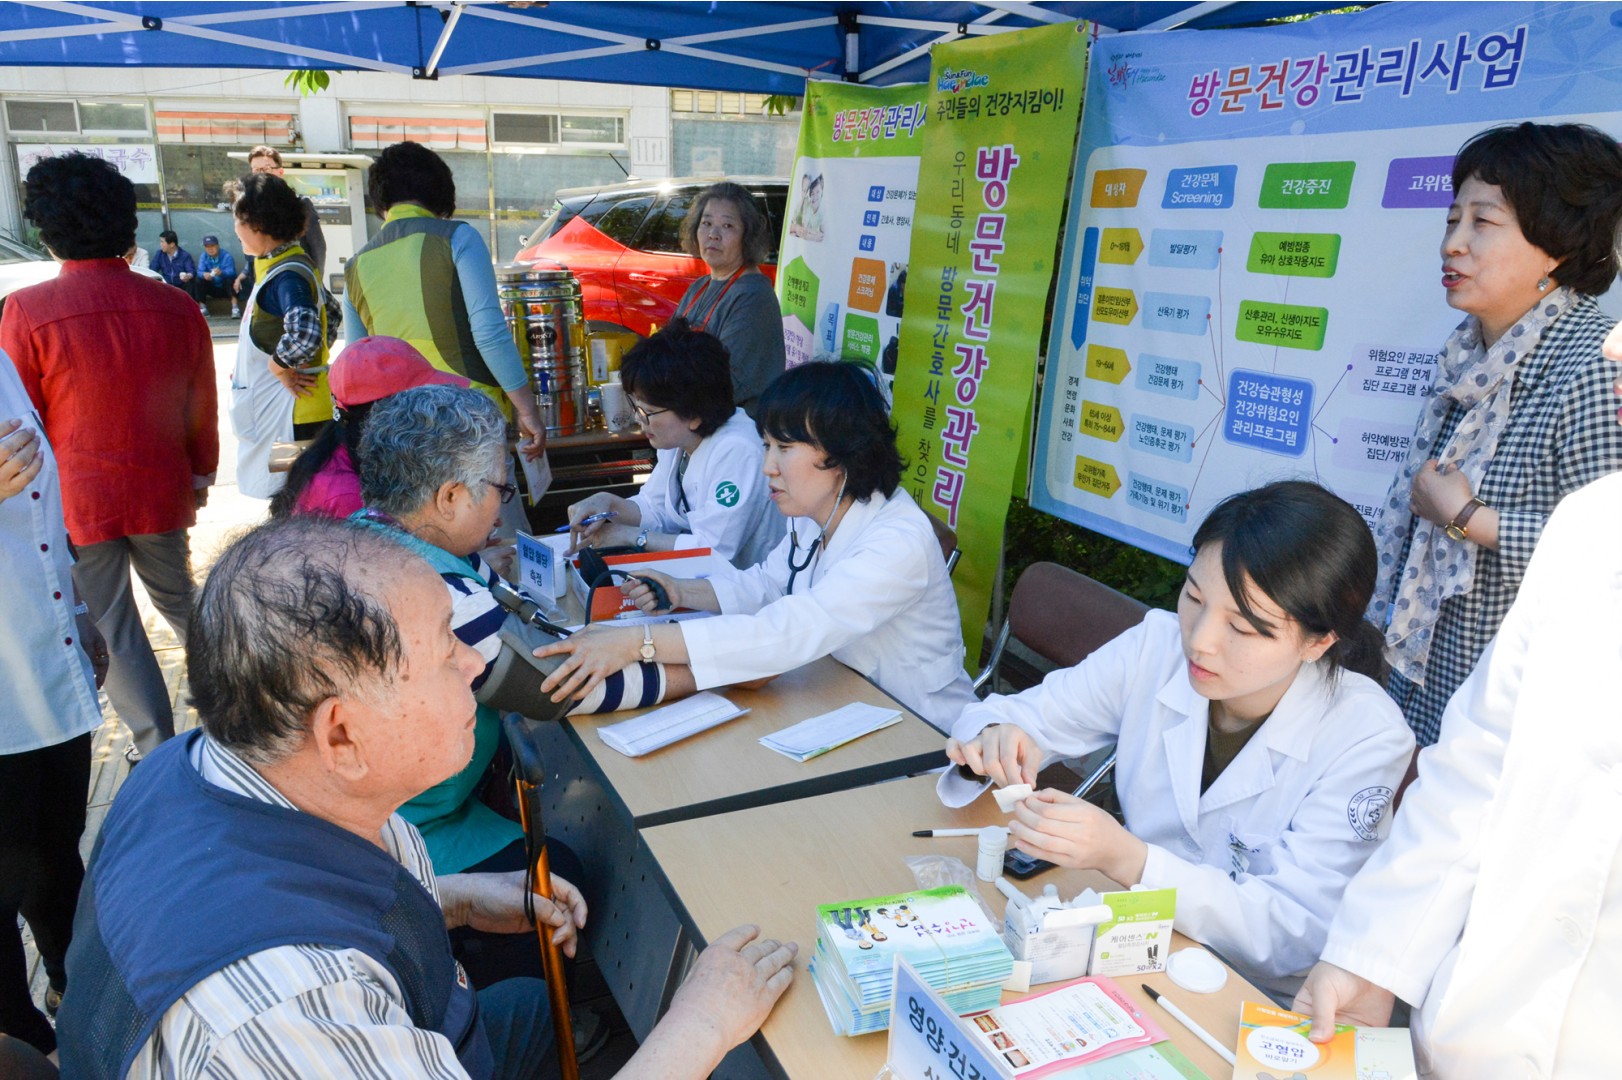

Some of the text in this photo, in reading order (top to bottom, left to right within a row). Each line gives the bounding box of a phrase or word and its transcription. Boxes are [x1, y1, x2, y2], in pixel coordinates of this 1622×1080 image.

[1187, 25, 1528, 117] 방문건강관리사업
[937, 73, 989, 93] Haeundae
[937, 88, 1064, 121] 주민들의 건강지킴이!
[1181, 173, 1219, 188] 건강문제
[1281, 178, 1332, 195] 건강증진
[1105, 183, 1127, 196] 대상자
[946, 151, 966, 254] 우리동네
[1171, 191, 1223, 206] Screening
[1169, 243, 1197, 255] 발달평가
[1278, 240, 1311, 253] 예방접종
[1260, 253, 1325, 268] 유아 상호작용지도
[1157, 306, 1190, 319] 산욕기 평가
[1244, 309, 1320, 327] 산후관리, 신생아지도
[933, 145, 1018, 527] 방문건강관리
[1256, 325, 1302, 340] 모유수유지도
[923, 266, 957, 430] 방문간호사를
[1368, 349, 1406, 364] 위험요인
[1155, 363, 1179, 377] 건강행태
[1375, 366, 1431, 381] 프로그램 연계
[1068, 376, 1080, 387] 경제
[1148, 374, 1184, 391] 건강문제 평가
[1363, 379, 1380, 392] 집단
[1381, 381, 1416, 396] 프로그램
[1237, 380, 1304, 406] 건강습관형성
[1064, 403, 1076, 414] 문화
[1235, 399, 1300, 426] 건강위험요인
[1062, 417, 1074, 428] 사회
[1100, 411, 1112, 423] 이상
[1061, 430, 1073, 442] 건강
[1160, 427, 1172, 439] 문제
[1174, 429, 1187, 442] 평가
[1232, 419, 1298, 447] 관리프로그램
[1138, 434, 1180, 453] 노인증후군 평가
[1155, 486, 1167, 498] 문제
[1169, 488, 1181, 502] 평가
[1150, 497, 1156, 508] 및
[1157, 499, 1169, 512] 위기
[1171, 502, 1184, 516] 평가
[1110, 934, 1143, 943] 케어센스
[1258, 1041, 1305, 1058] 고혈압
